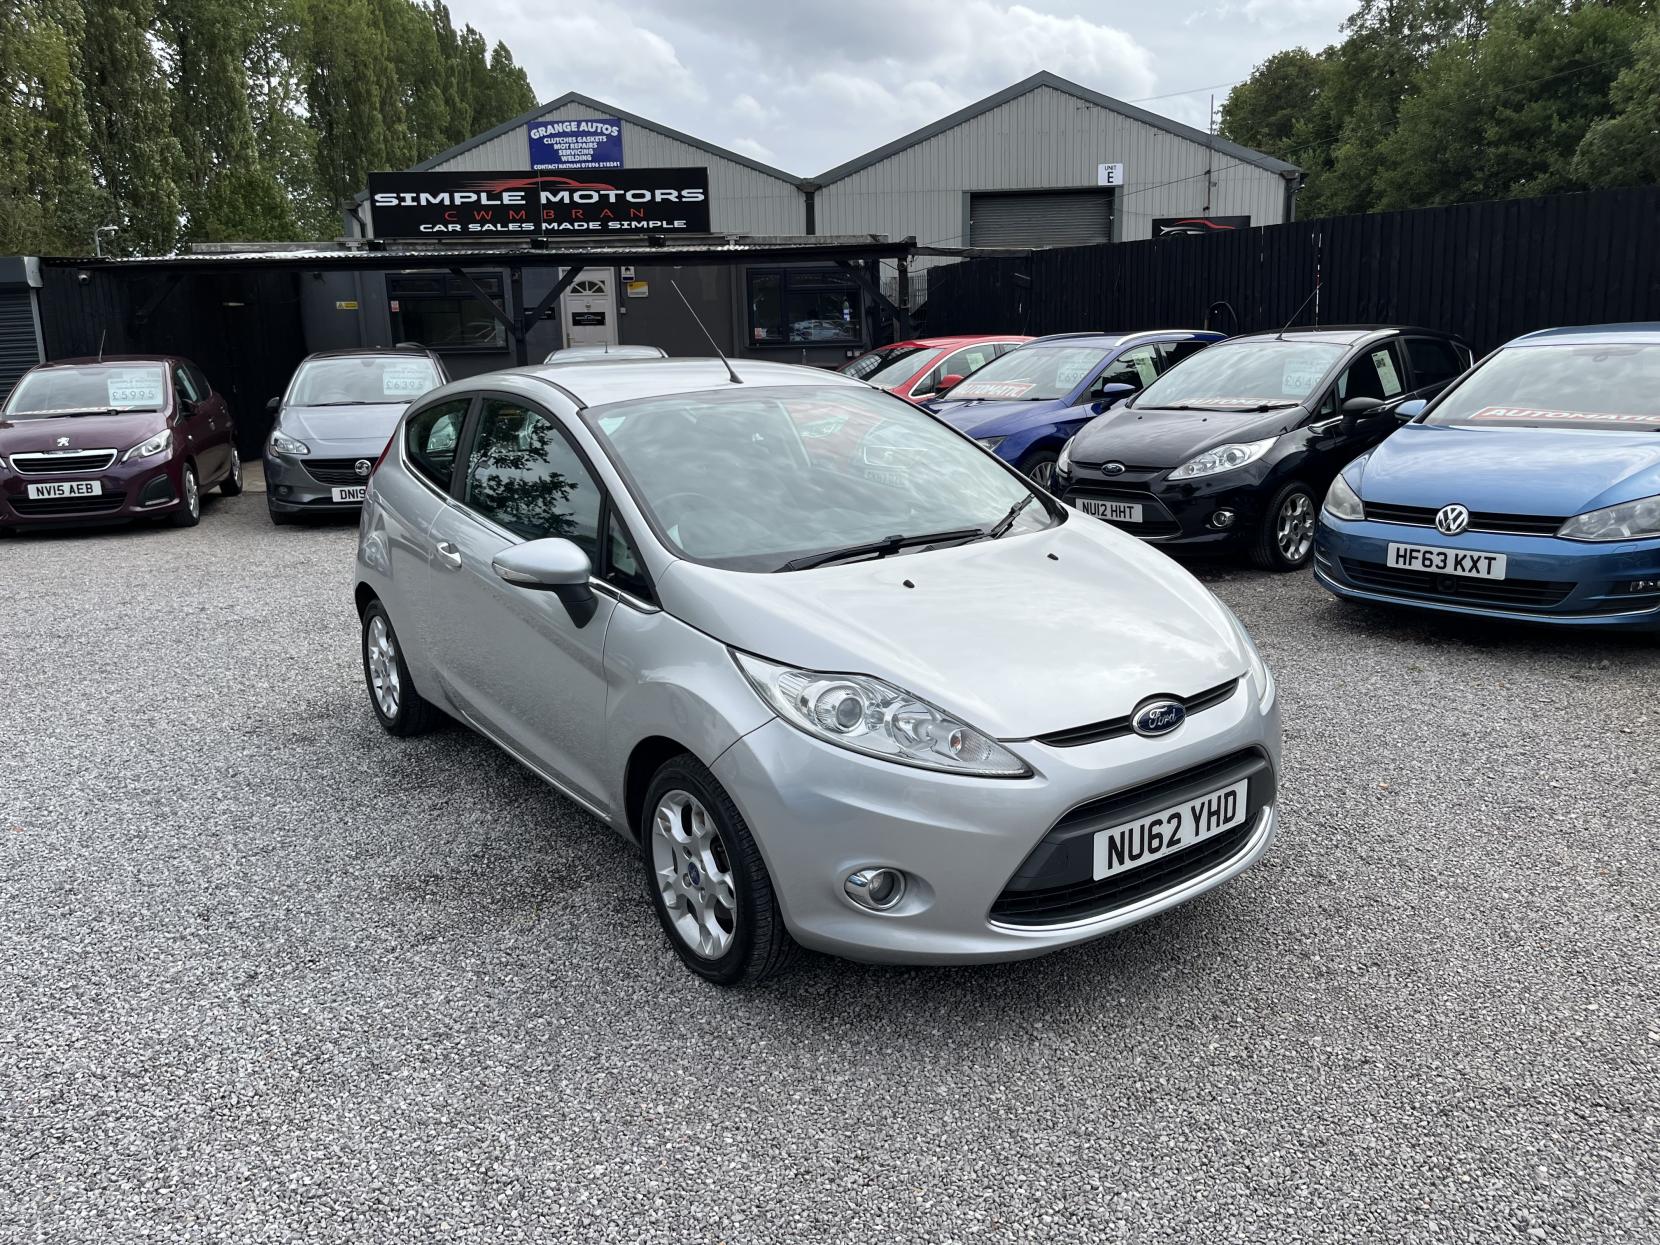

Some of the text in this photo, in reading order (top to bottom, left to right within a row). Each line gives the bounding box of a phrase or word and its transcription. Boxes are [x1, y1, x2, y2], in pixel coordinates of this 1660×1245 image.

[530, 121, 619, 139] GRANGE AUTOS
[1107, 171, 1114, 184] E
[374, 188, 705, 206] SIMPLE MOTORS
[444, 208, 644, 221] CWMBRAN
[419, 220, 687, 232] CAR SALES MADE SIMPLE
[112, 390, 154, 401] £5995
[36, 483, 94, 497] NV15 AEB
[340, 488, 366, 500] DN19
[1082, 501, 1134, 520] NU12 HHT
[1395, 547, 1497, 575] HF63 KXT
[1149, 707, 1177, 728] Ford
[1107, 789, 1237, 871] NU62 YHD
